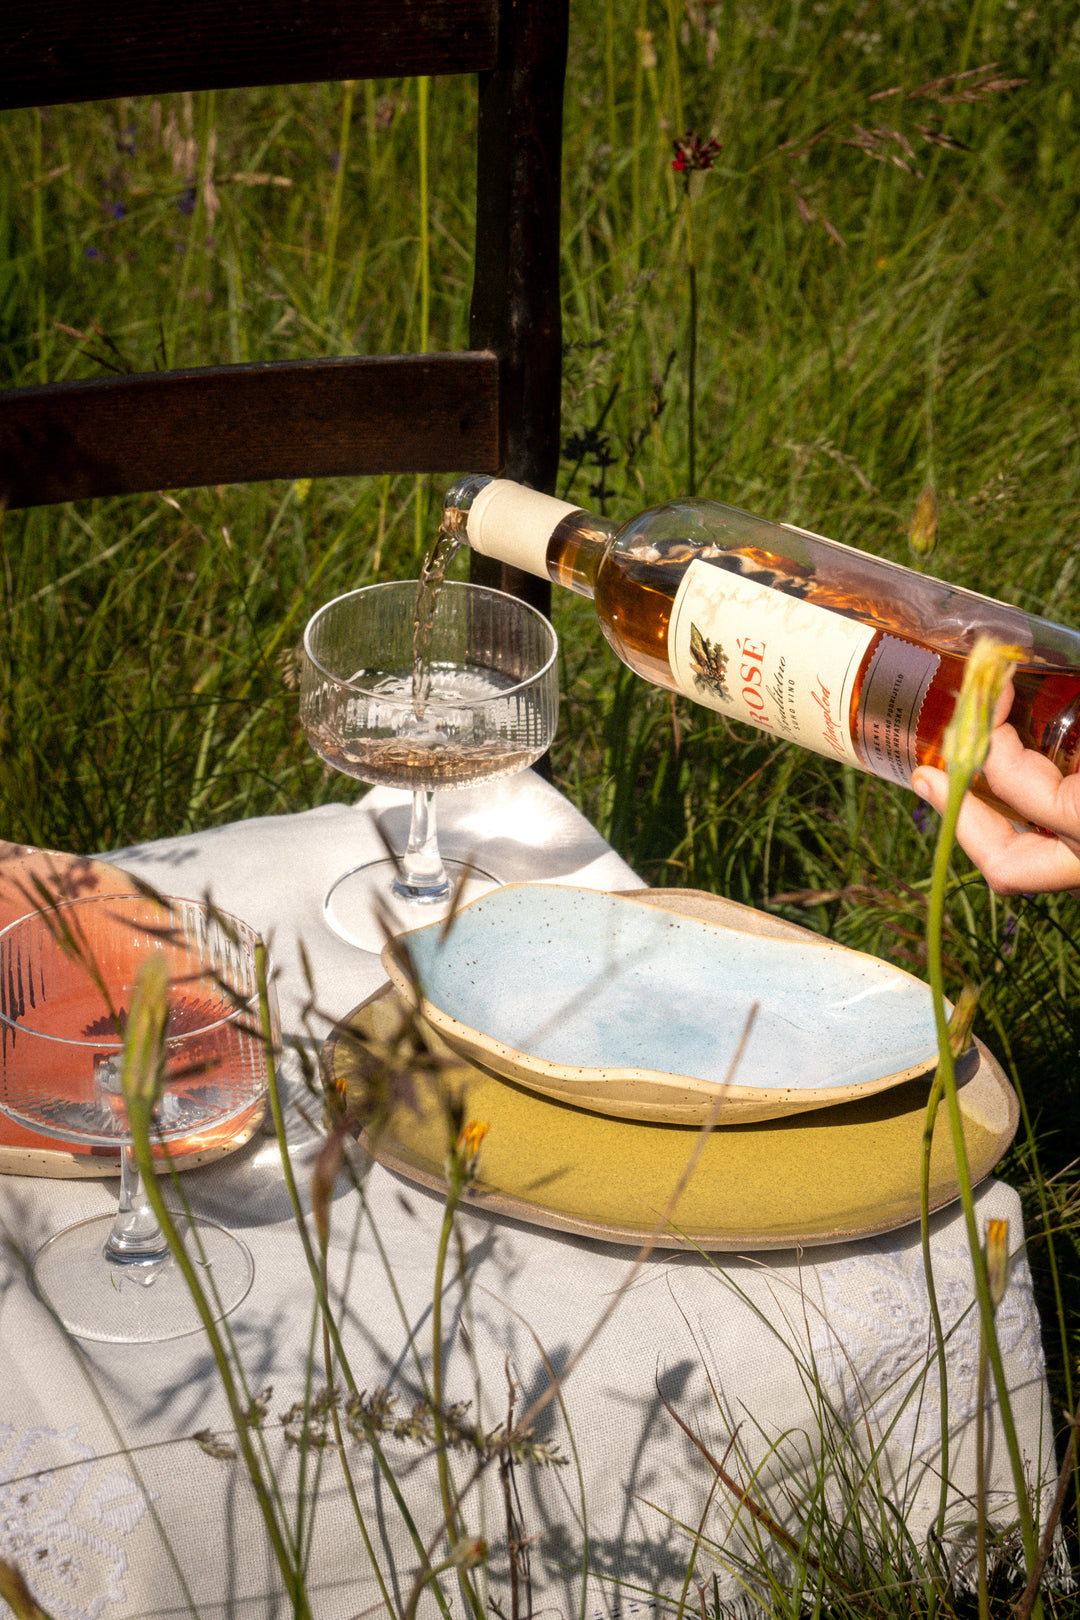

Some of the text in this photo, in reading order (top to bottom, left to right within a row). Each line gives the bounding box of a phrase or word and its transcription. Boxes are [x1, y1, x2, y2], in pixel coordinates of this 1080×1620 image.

[736, 637, 773, 729] ROSÉ
[788, 680, 796, 703] VINO
[893, 708, 903, 749] HRVATSKA
